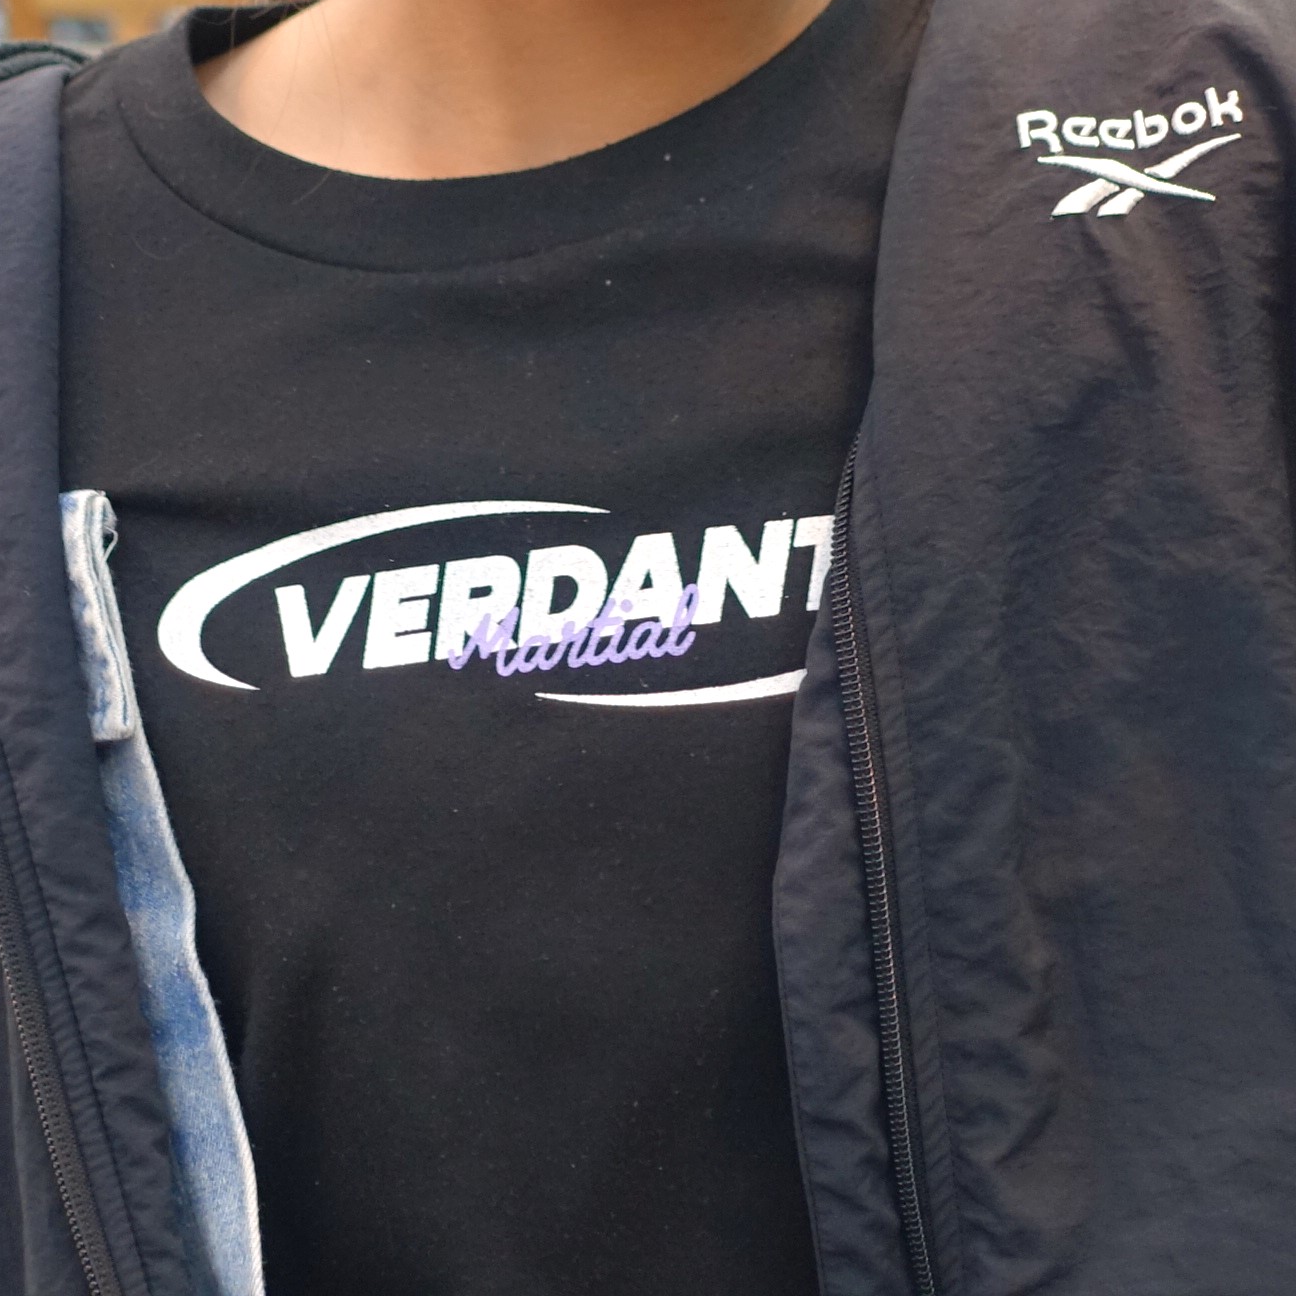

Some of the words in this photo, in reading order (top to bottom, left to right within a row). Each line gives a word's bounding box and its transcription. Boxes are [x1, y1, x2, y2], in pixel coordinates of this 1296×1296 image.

[1016, 87, 1244, 155] Reebok
[274, 515, 836, 678] VERDANT
[448, 583, 699, 677] Martial
